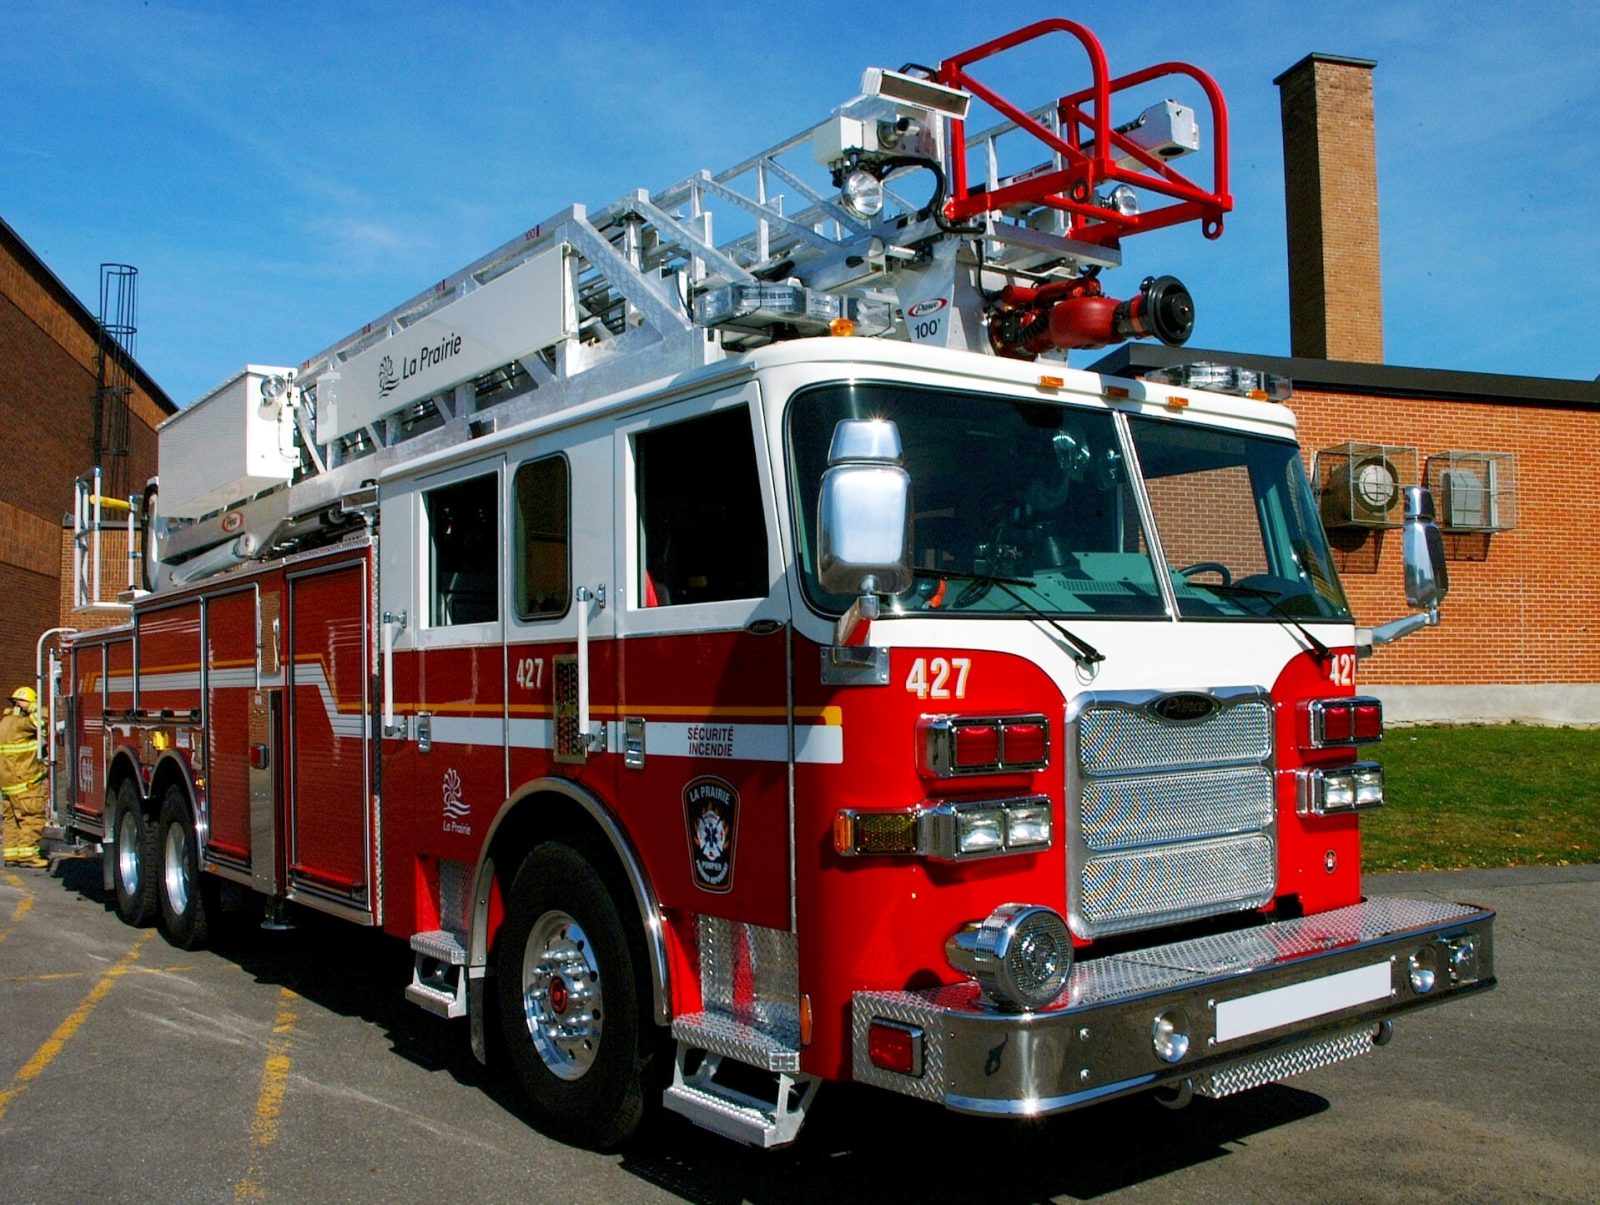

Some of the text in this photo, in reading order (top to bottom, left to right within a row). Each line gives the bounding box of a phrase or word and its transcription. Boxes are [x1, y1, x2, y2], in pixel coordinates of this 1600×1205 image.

[403, 332, 462, 380] La Prairie
[516, 657, 544, 689] 427
[905, 657, 972, 700] 427
[687, 725, 734, 742] SÉCURITÉ
[688, 742, 733, 757] INCENDIE
[690, 786, 731, 806] LA PRAIRIE
[443, 820, 451, 831] La
